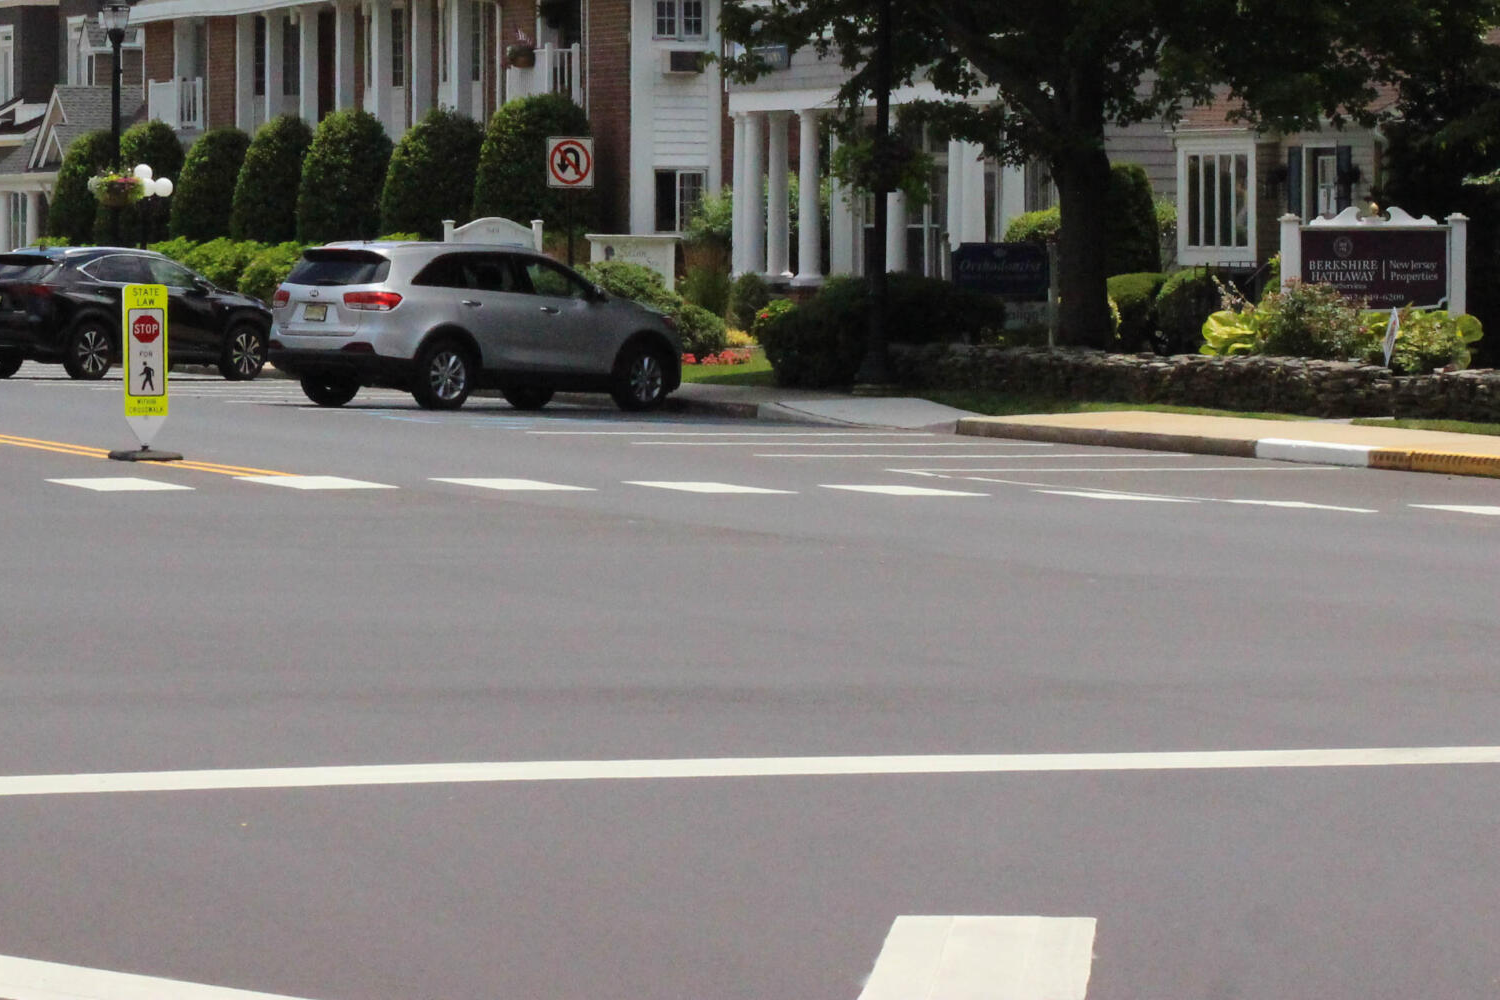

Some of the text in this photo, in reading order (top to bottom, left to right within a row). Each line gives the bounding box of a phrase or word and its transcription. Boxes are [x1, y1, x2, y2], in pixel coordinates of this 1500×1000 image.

[1309, 260, 1378, 270] BERKSHIRE
[1389, 260, 1438, 272] New Jersey
[1311, 271, 1376, 281] HATHAWAY
[1390, 271, 1438, 283] Properties
[133, 288, 160, 296] STATE
[133, 324, 159, 334] STOP
